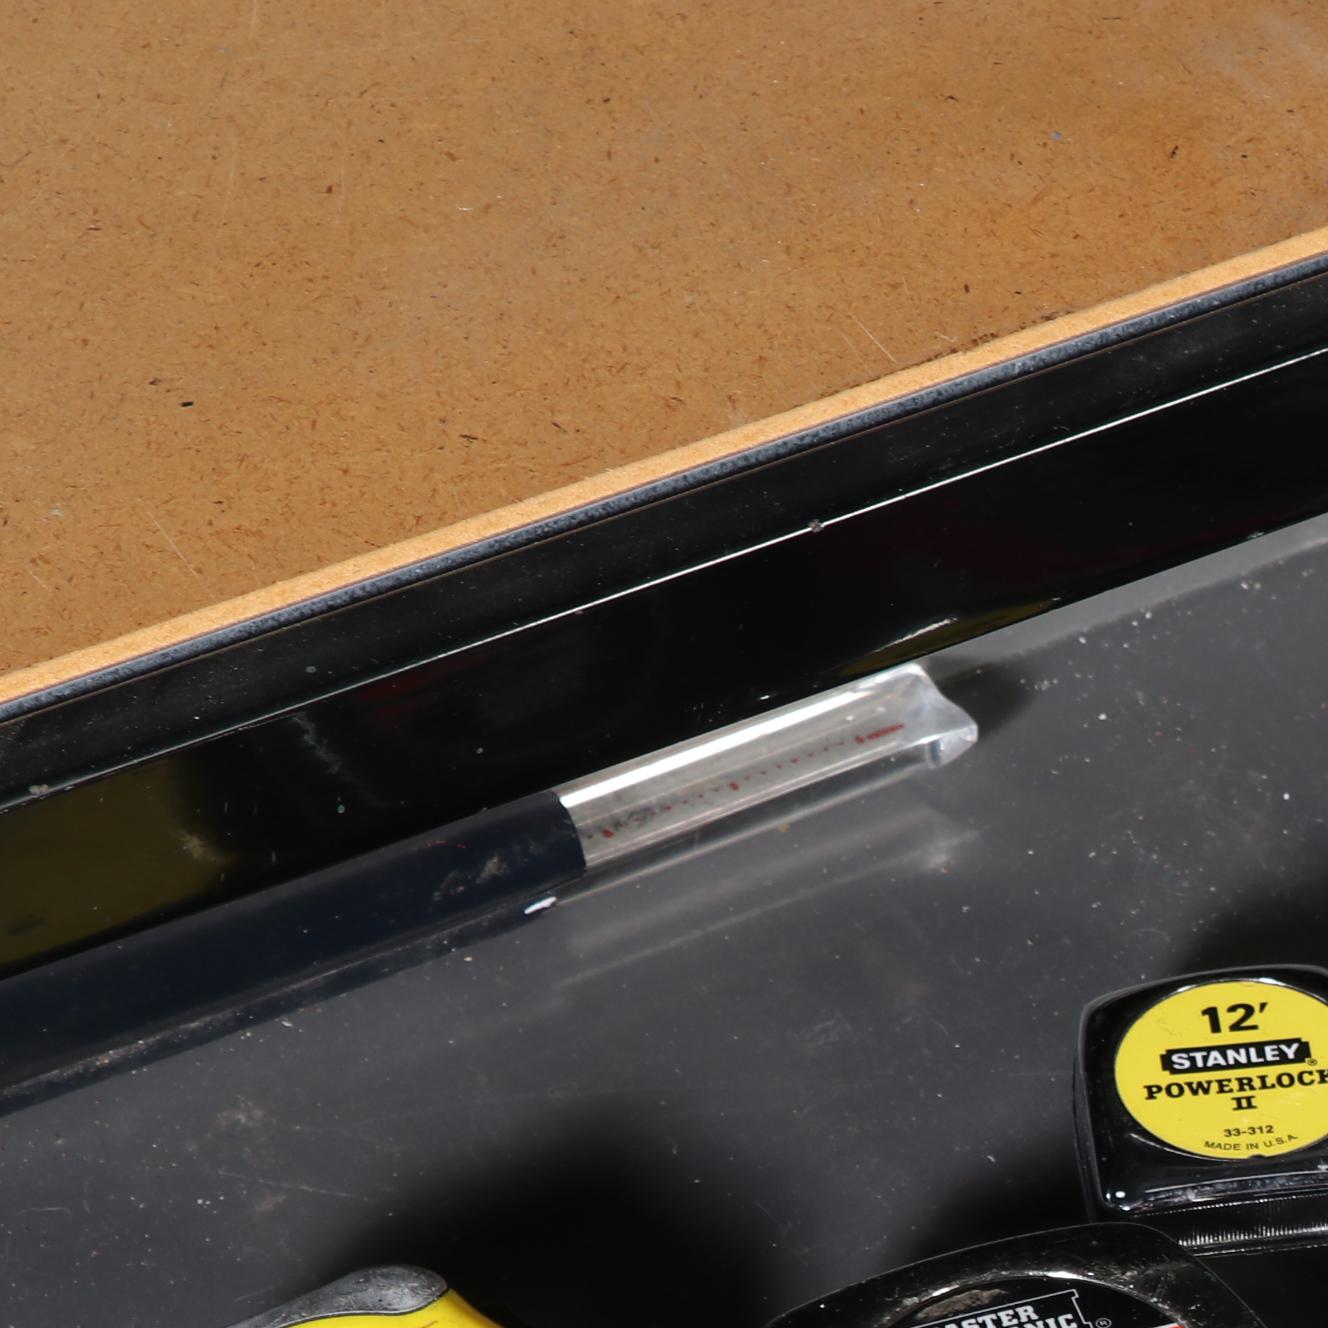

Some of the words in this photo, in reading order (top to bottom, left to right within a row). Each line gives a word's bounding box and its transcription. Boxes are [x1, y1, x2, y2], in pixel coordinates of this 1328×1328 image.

[1201, 1002, 1268, 1034] 12'
[1170, 1042, 1299, 1070] STANLEY
[1232, 1096, 1258, 1111] II
[1223, 1124, 1274, 1138] 33-312
[1203, 1140, 1242, 1151] MADE
[1245, 1141, 1260, 1150] IN
